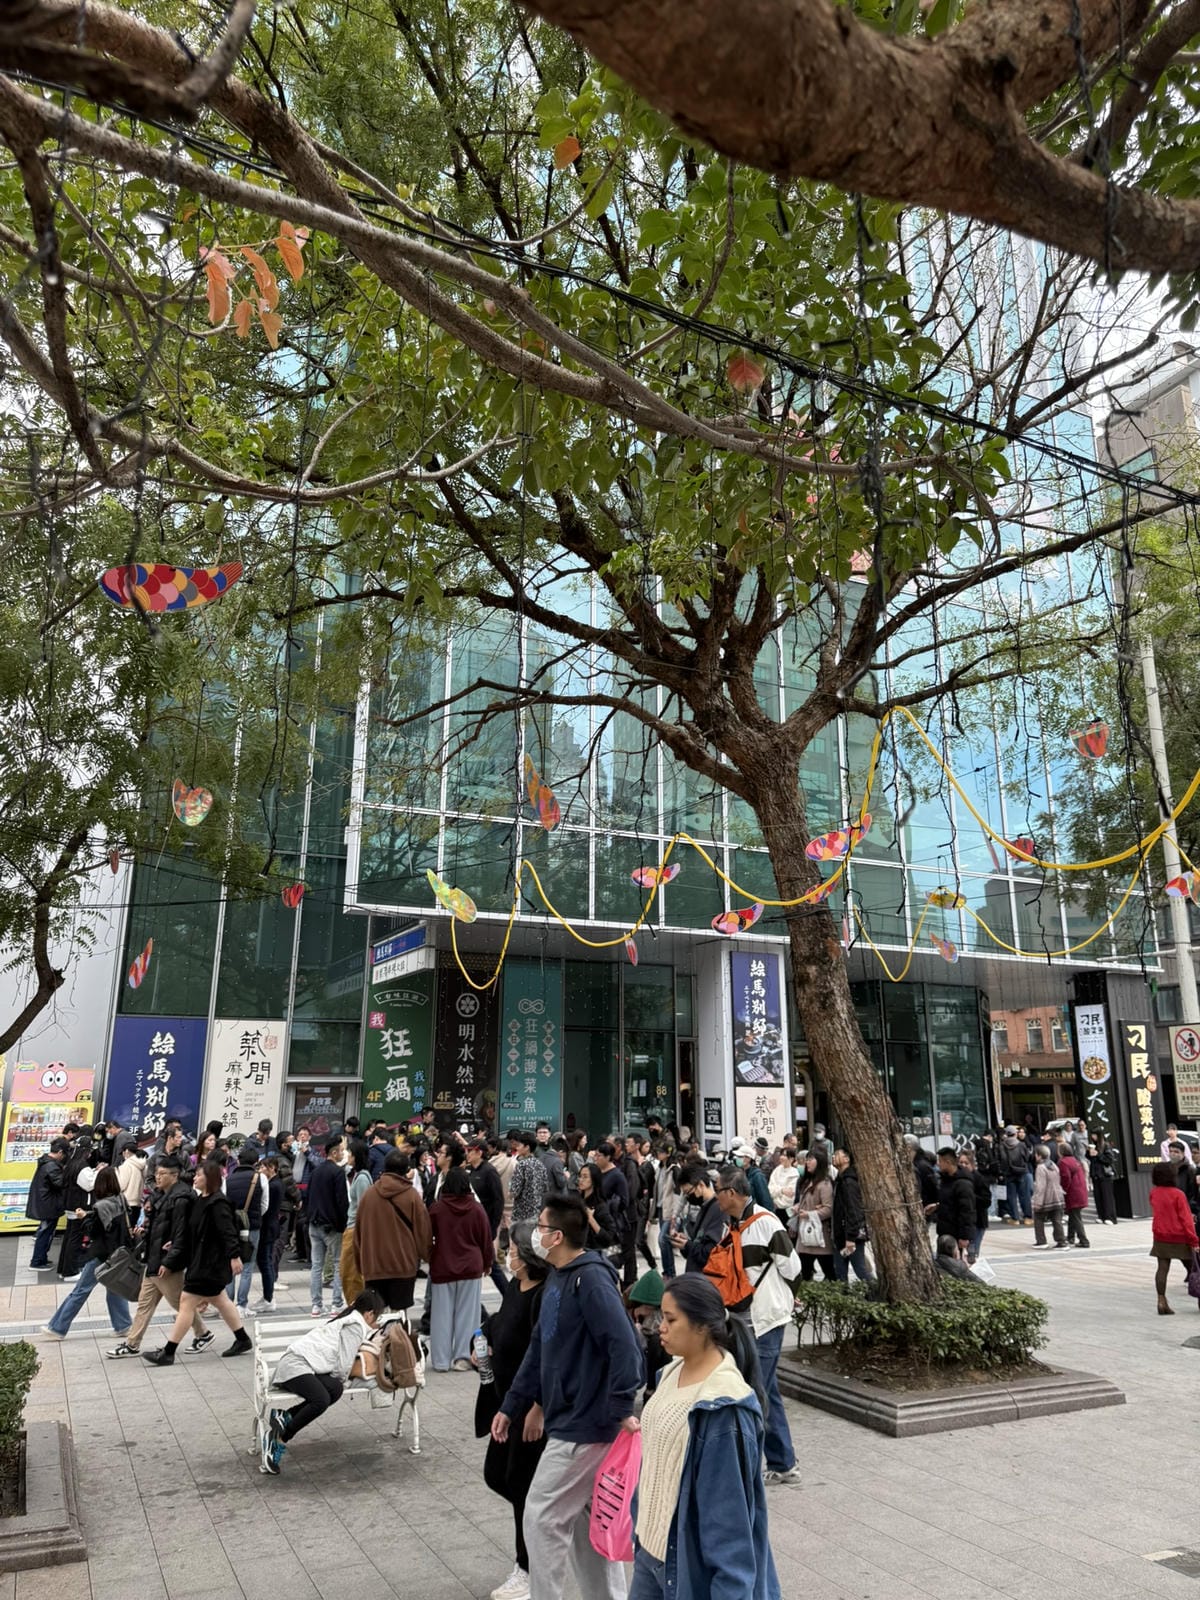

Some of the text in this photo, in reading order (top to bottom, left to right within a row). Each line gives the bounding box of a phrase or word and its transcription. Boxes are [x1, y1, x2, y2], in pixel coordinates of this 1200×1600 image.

[371, 1013, 384, 1026] 我
[239, 1029, 272, 1085] 築間
[379, 1027, 414, 1103] 狂一鍋
[524, 1018, 539, 1113] 狂一鍋酸菜魚
[1126, 1025, 1151, 1079] 刁民
[221, 1060, 244, 1129] 麻辣火鍋
[367, 1091, 382, 1102] 4F
[437, 1091, 452, 1102] 4F
[504, 1092, 519, 1102] 4F
[656, 1085, 668, 1095] 88
[1136, 1088, 1157, 1146] 酸菜魚
